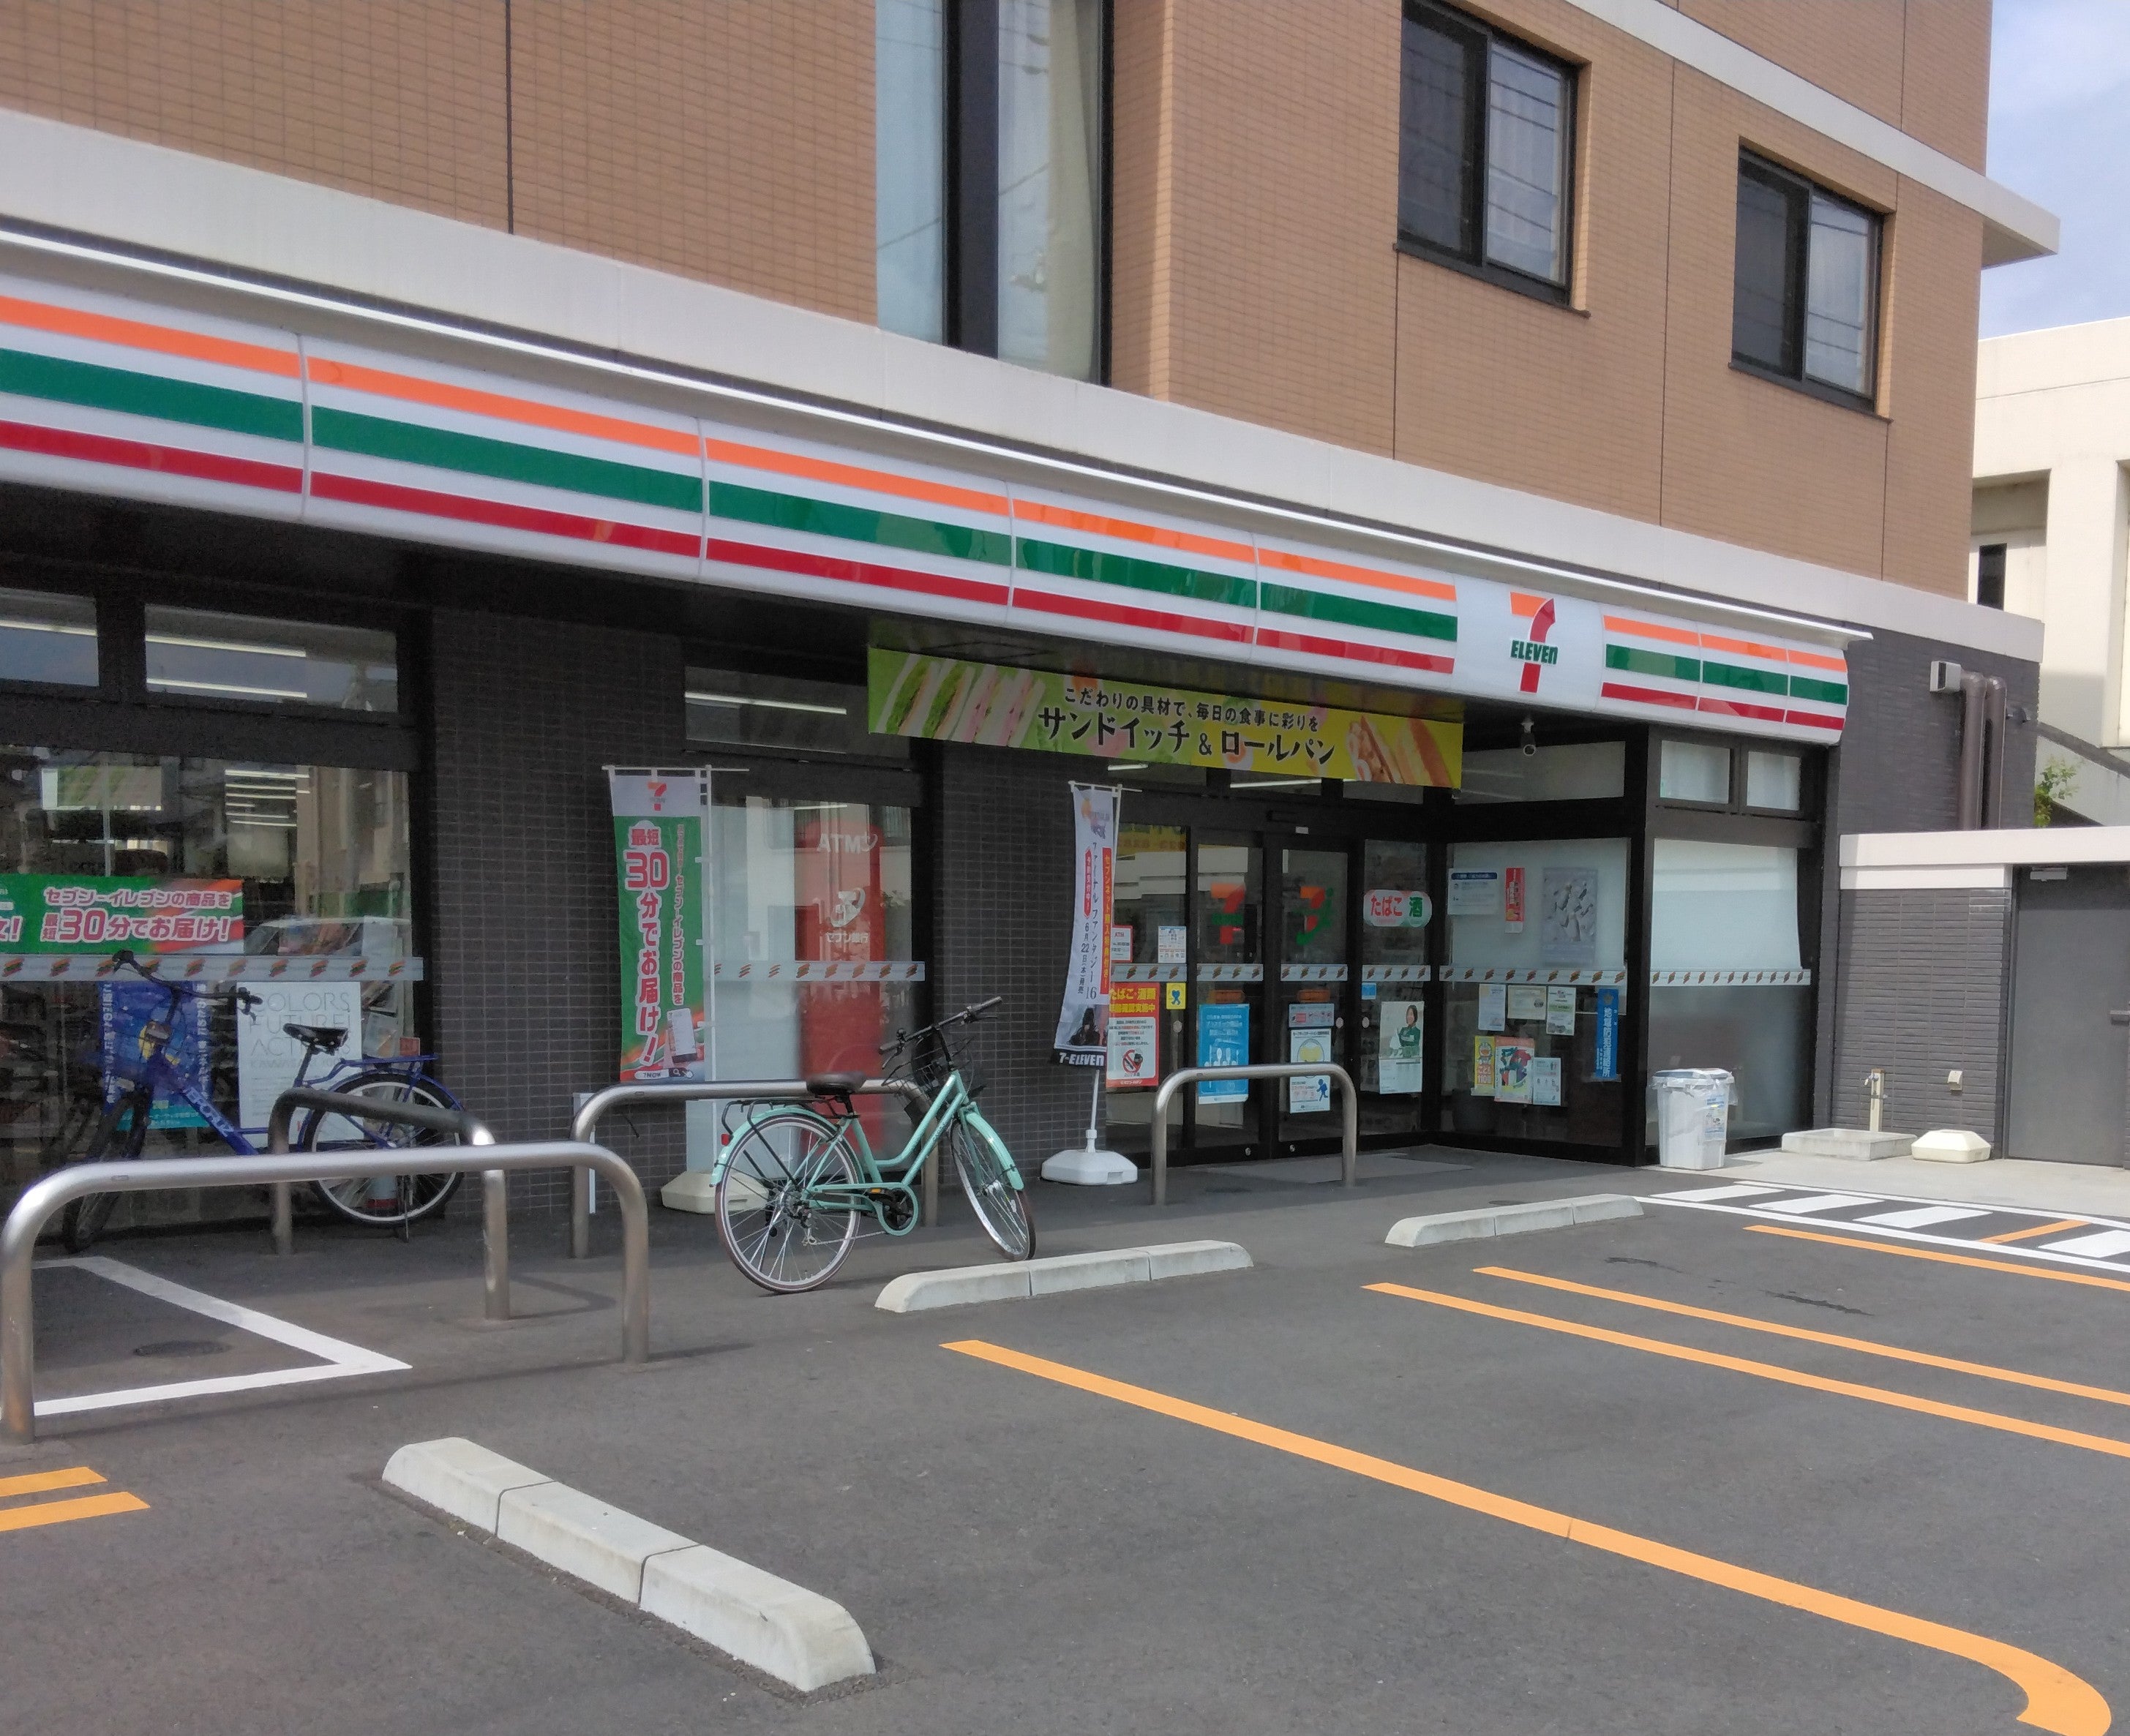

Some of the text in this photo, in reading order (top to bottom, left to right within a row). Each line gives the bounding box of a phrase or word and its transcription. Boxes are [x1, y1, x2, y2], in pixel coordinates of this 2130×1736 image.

[1065, 687, 1318, 732] こだわりの具材で、毎日の食事に彩りを
[817, 833, 861, 852] ATM
[1370, 895, 1423, 917] たばこ 酒
